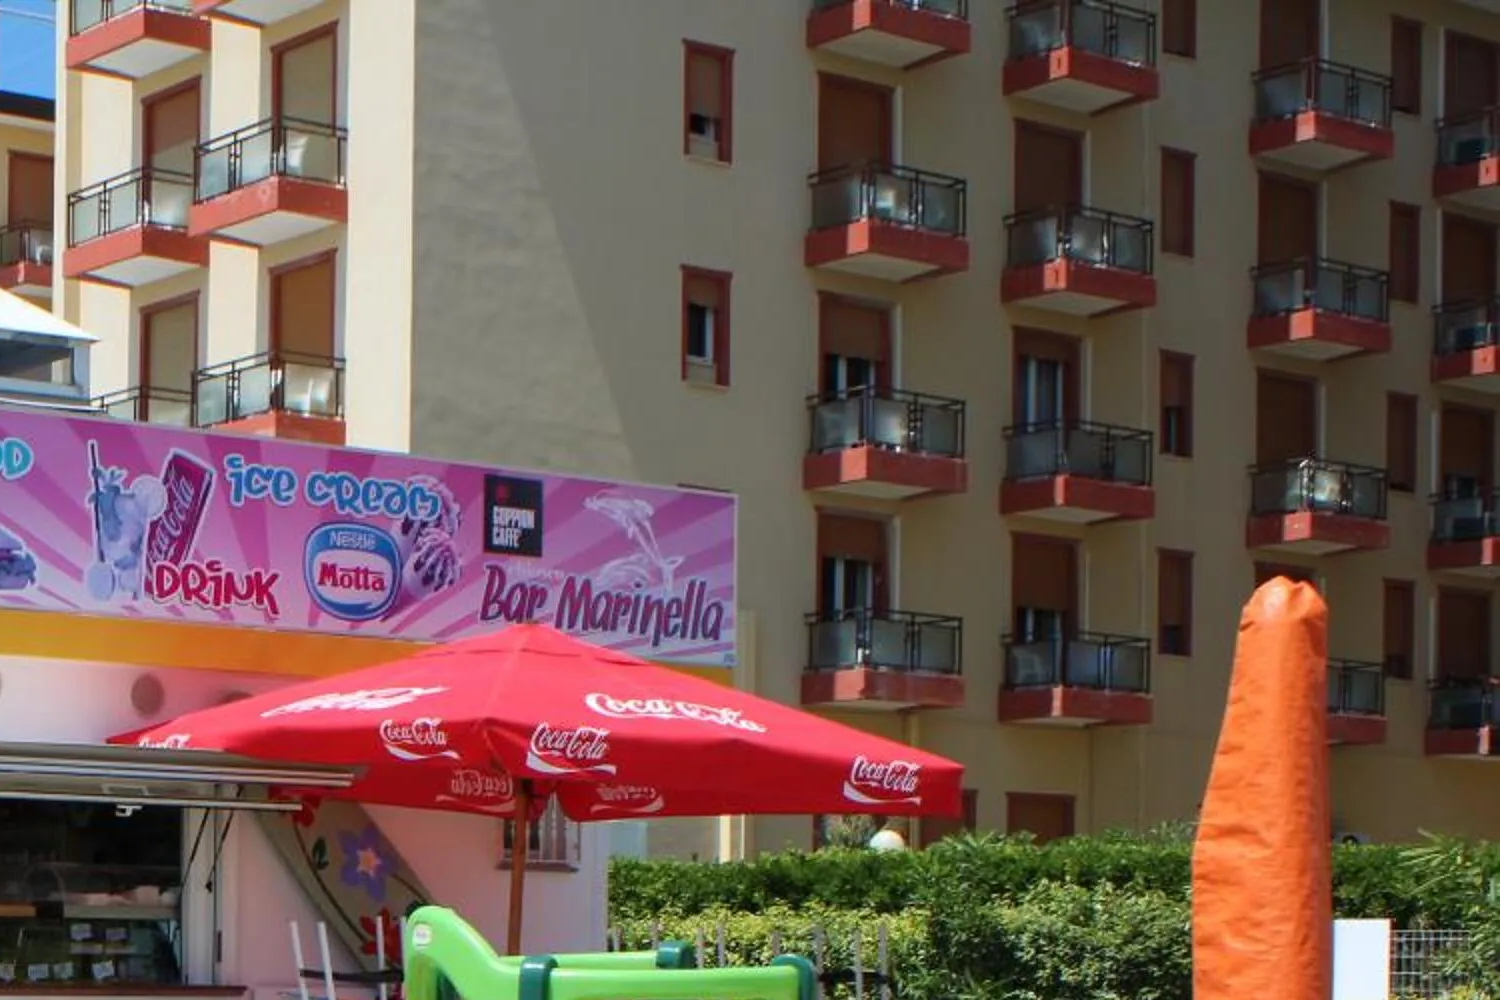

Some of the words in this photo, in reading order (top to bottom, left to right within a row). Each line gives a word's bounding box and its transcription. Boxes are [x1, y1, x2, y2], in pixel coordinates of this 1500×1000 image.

[317, 562, 386, 592] Motta
[480, 564, 549, 623] Bar
[555, 575, 724, 647] Marinella
